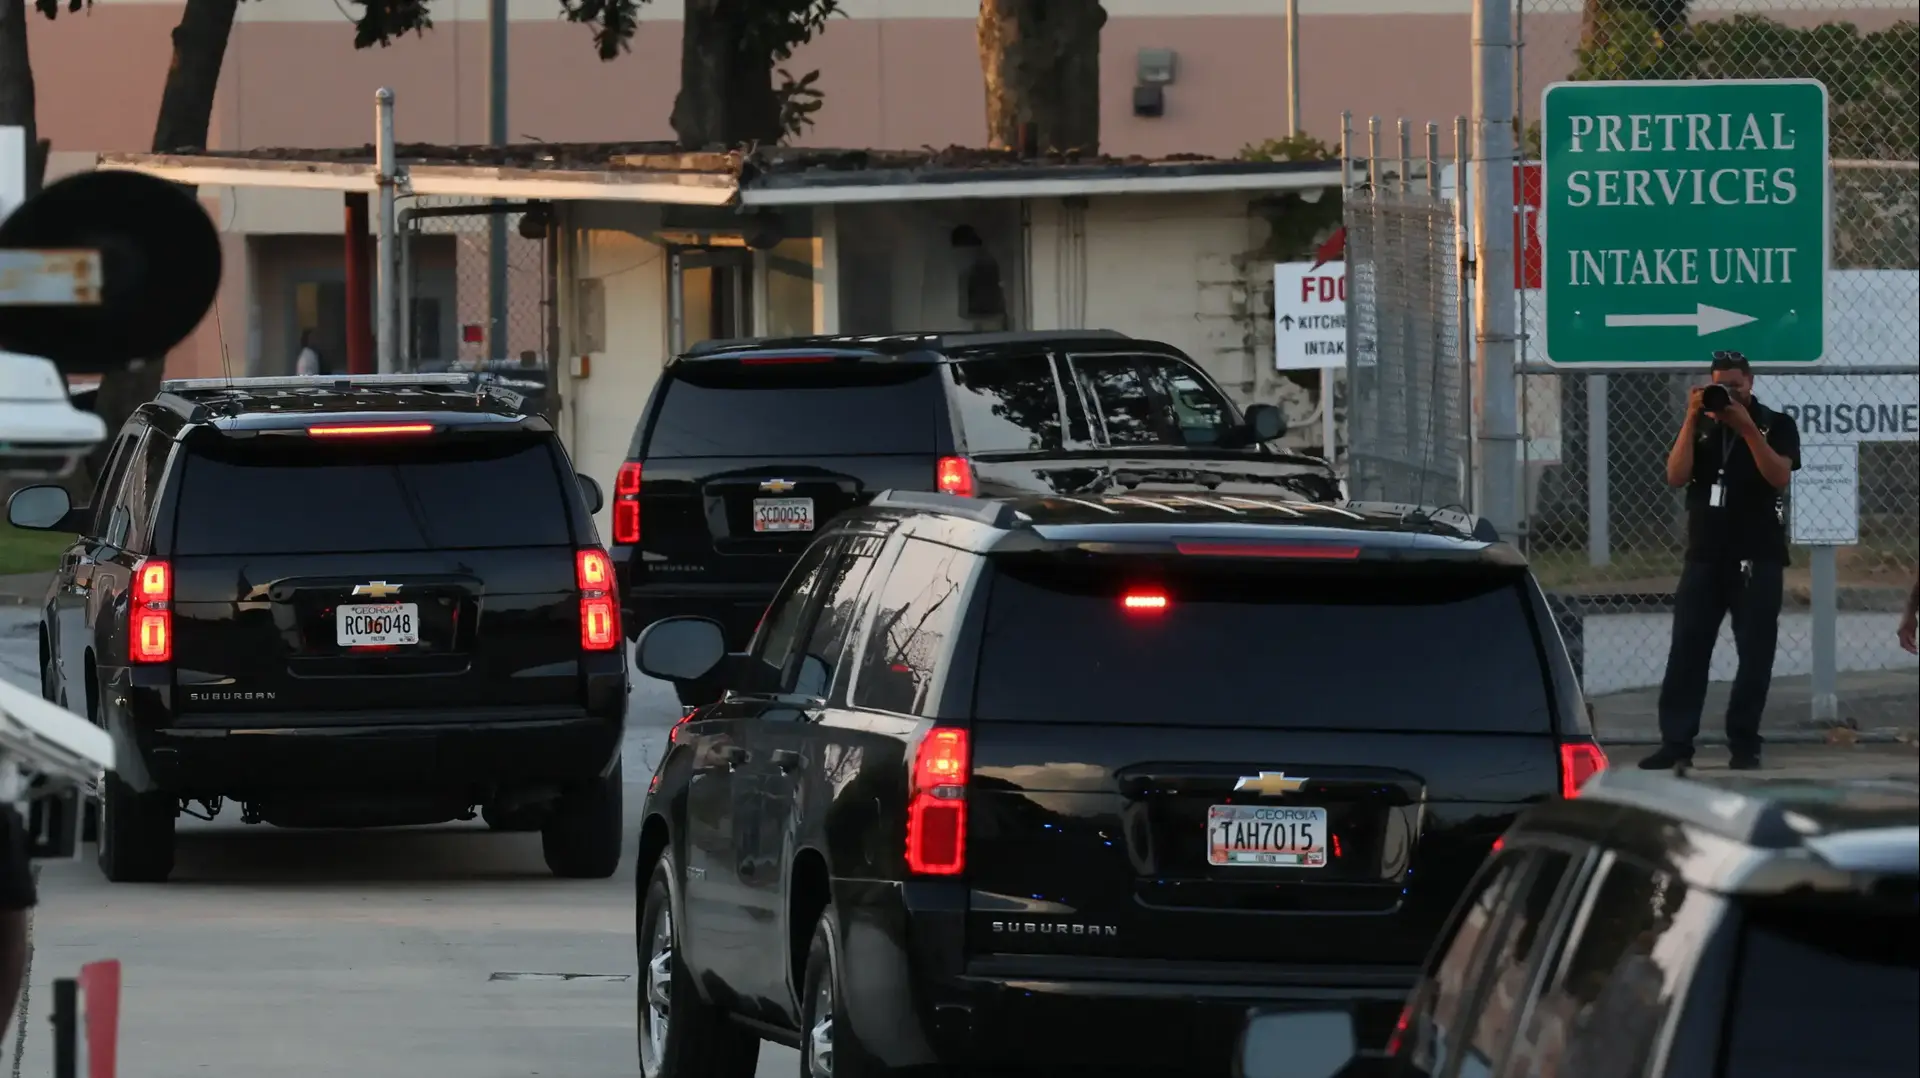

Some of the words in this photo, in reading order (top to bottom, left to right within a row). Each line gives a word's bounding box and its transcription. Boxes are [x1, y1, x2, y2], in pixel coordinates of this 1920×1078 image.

[1568, 112, 1795, 152] PRETRIAL
[1567, 167, 1797, 207] SERVICES
[1568, 248, 1699, 285] INTAKE
[1708, 247, 1798, 284] UNIT
[759, 506, 808, 524] SCD0053
[354, 606, 399, 615] GEORGIA
[345, 614, 411, 635] RCD6048
[190, 692, 276, 700] SUBURBAN
[1254, 808, 1318, 821] GEORGIA
[1220, 821, 1313, 851] TAH7015
[992, 921, 1117, 936] SUBURBAN
